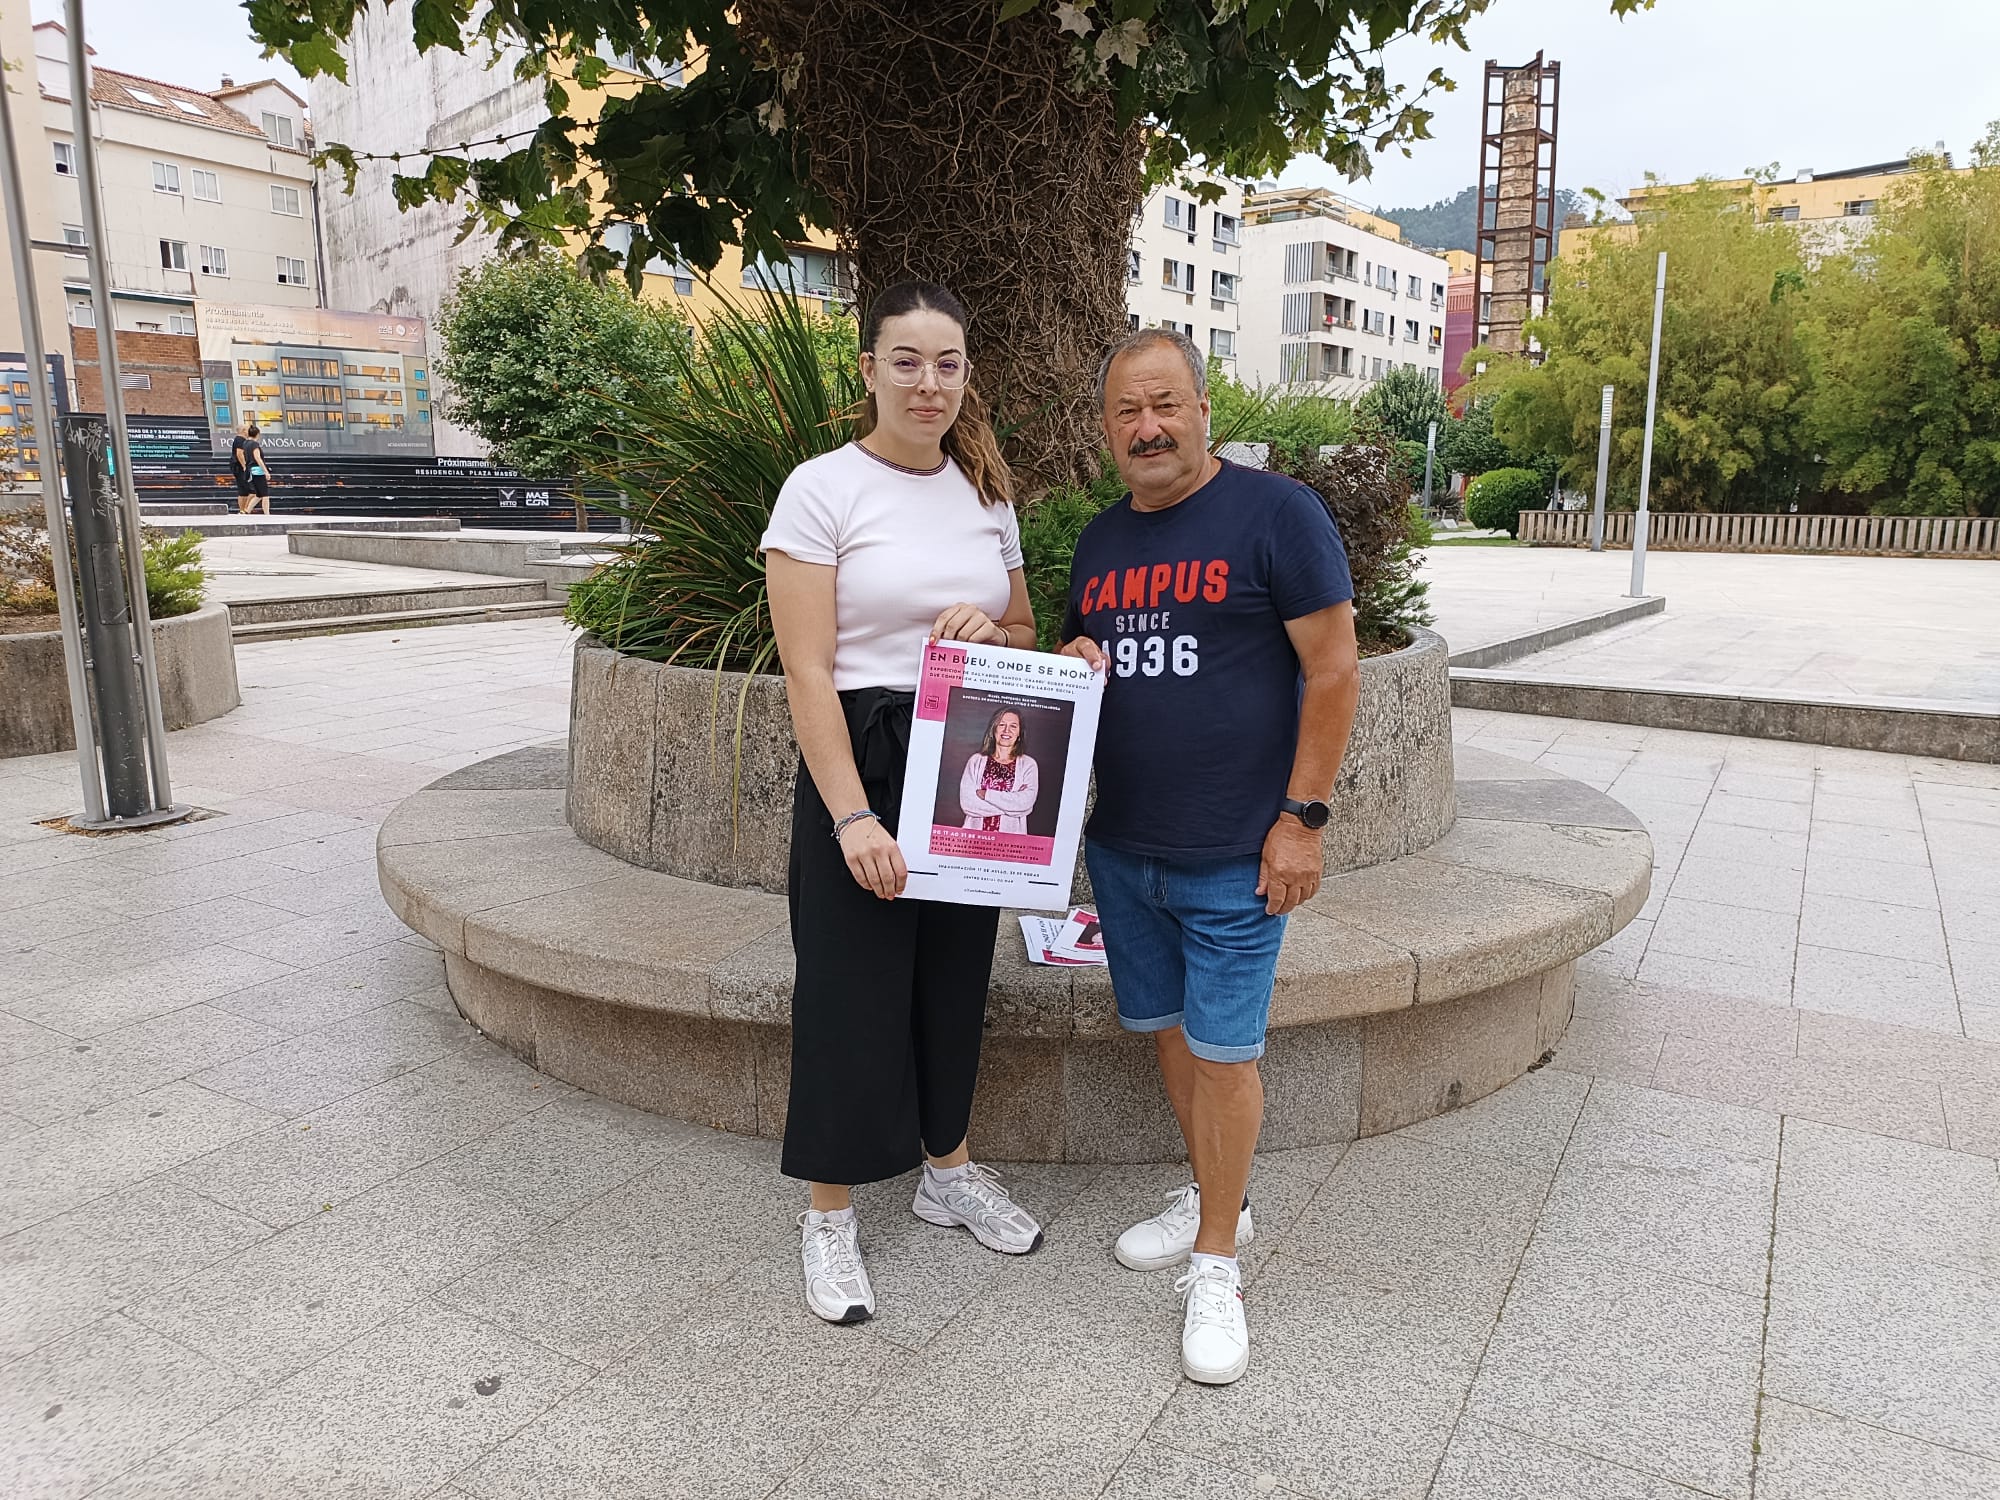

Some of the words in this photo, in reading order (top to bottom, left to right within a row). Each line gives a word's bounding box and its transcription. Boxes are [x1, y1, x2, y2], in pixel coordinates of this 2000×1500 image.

[220, 438, 295, 448] POANOSA
[297, 439, 321, 449] Grupo
[437, 458, 491, 467] Próximamen
[526, 491, 549, 499] MAS
[1081, 559, 1230, 616] CAMPUS
[1115, 611, 1170, 633] SINCE
[930, 652, 947, 662] EN
[952, 655, 991, 669] BUEU,
[996, 660, 1031, 673] ONDE
[1038, 665, 1054, 676] SE
[1059, 668, 1096, 681] NON?
